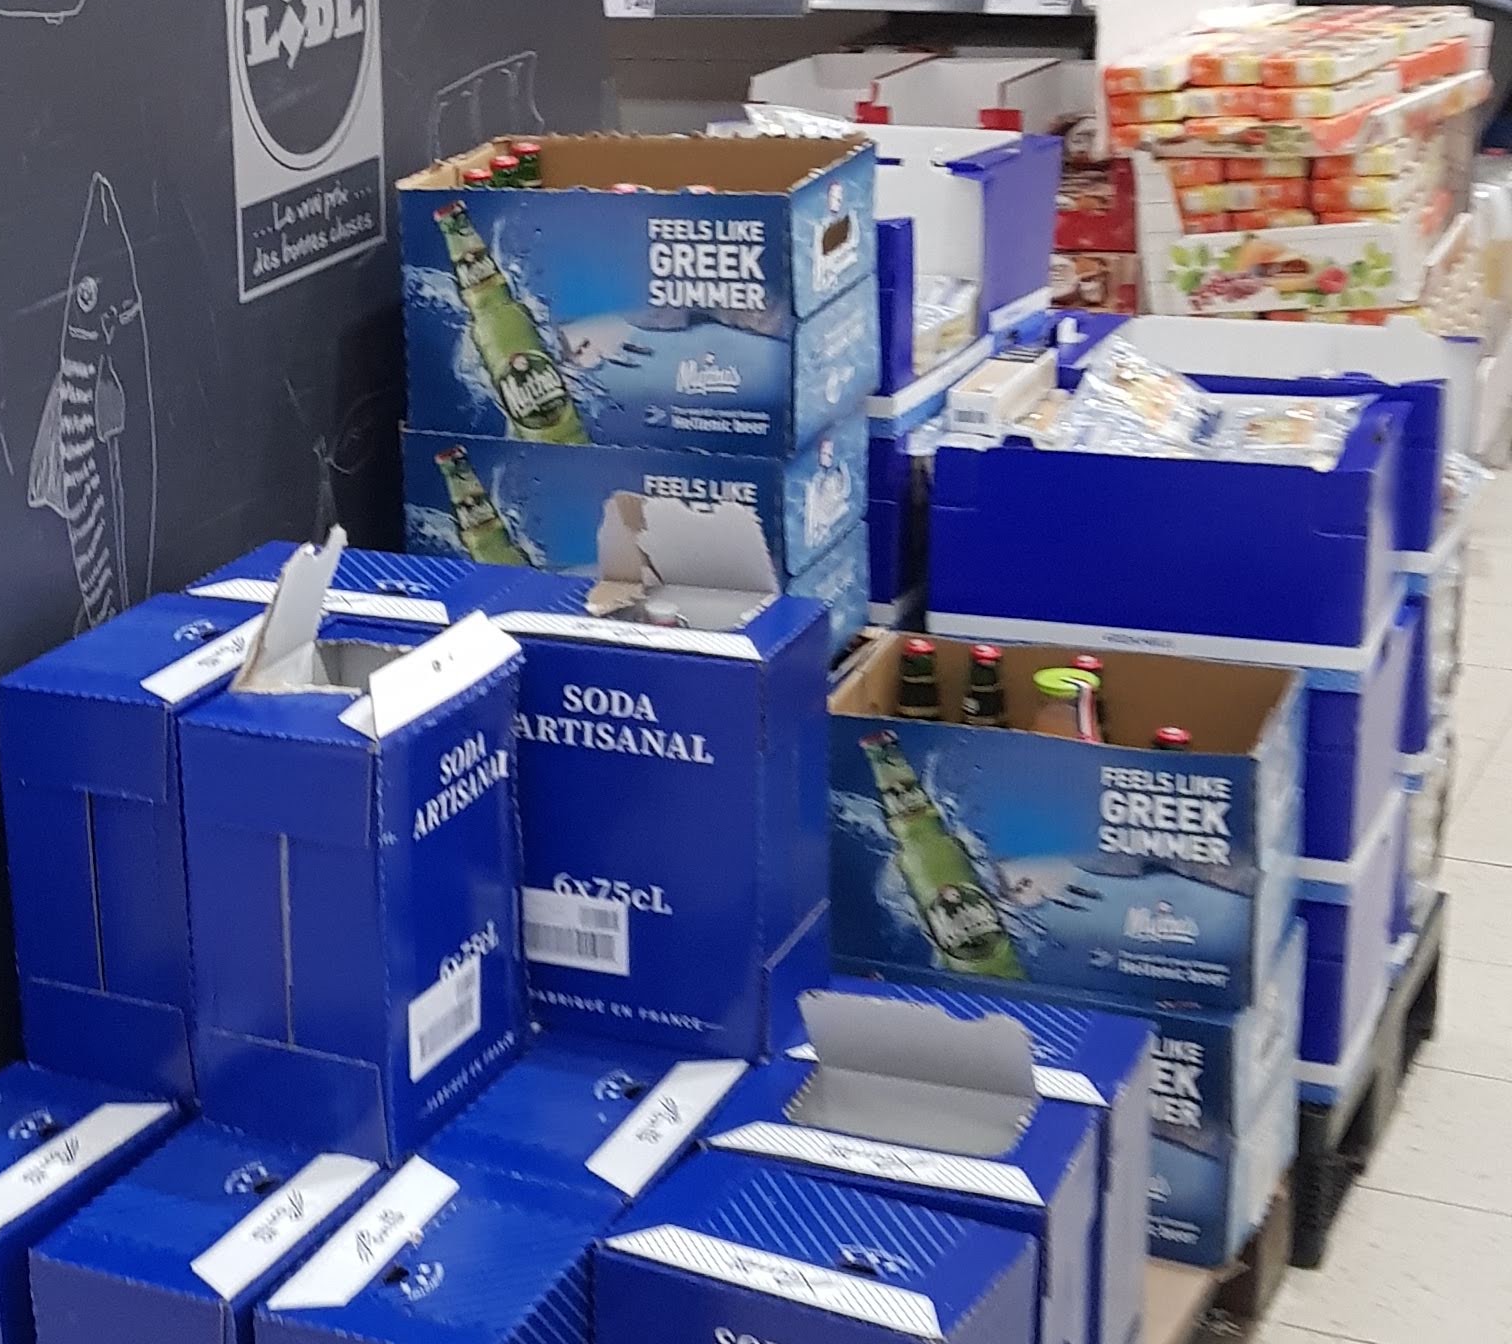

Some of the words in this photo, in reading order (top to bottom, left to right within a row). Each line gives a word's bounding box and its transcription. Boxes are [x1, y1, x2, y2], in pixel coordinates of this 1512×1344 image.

[647, 217, 714, 242] FEELS
[714, 219, 766, 244] LIKE
[648, 242, 767, 282] GREEK
[648, 279, 768, 311] SUMMER
[642, 473, 708, 500] FEELS
[710, 478, 759, 504] LIKE
[562, 684, 659, 725] SODA
[439, 731, 487, 787] SODA
[512, 711, 715, 766] ARTISANAL
[412, 749, 510, 843] ARTISANAL
[1099, 765, 1175, 794] FEELS
[1174, 773, 1233, 800] LIKE
[1098, 789, 1232, 838] GREEK
[1097, 825, 1232, 867] SUMMER
